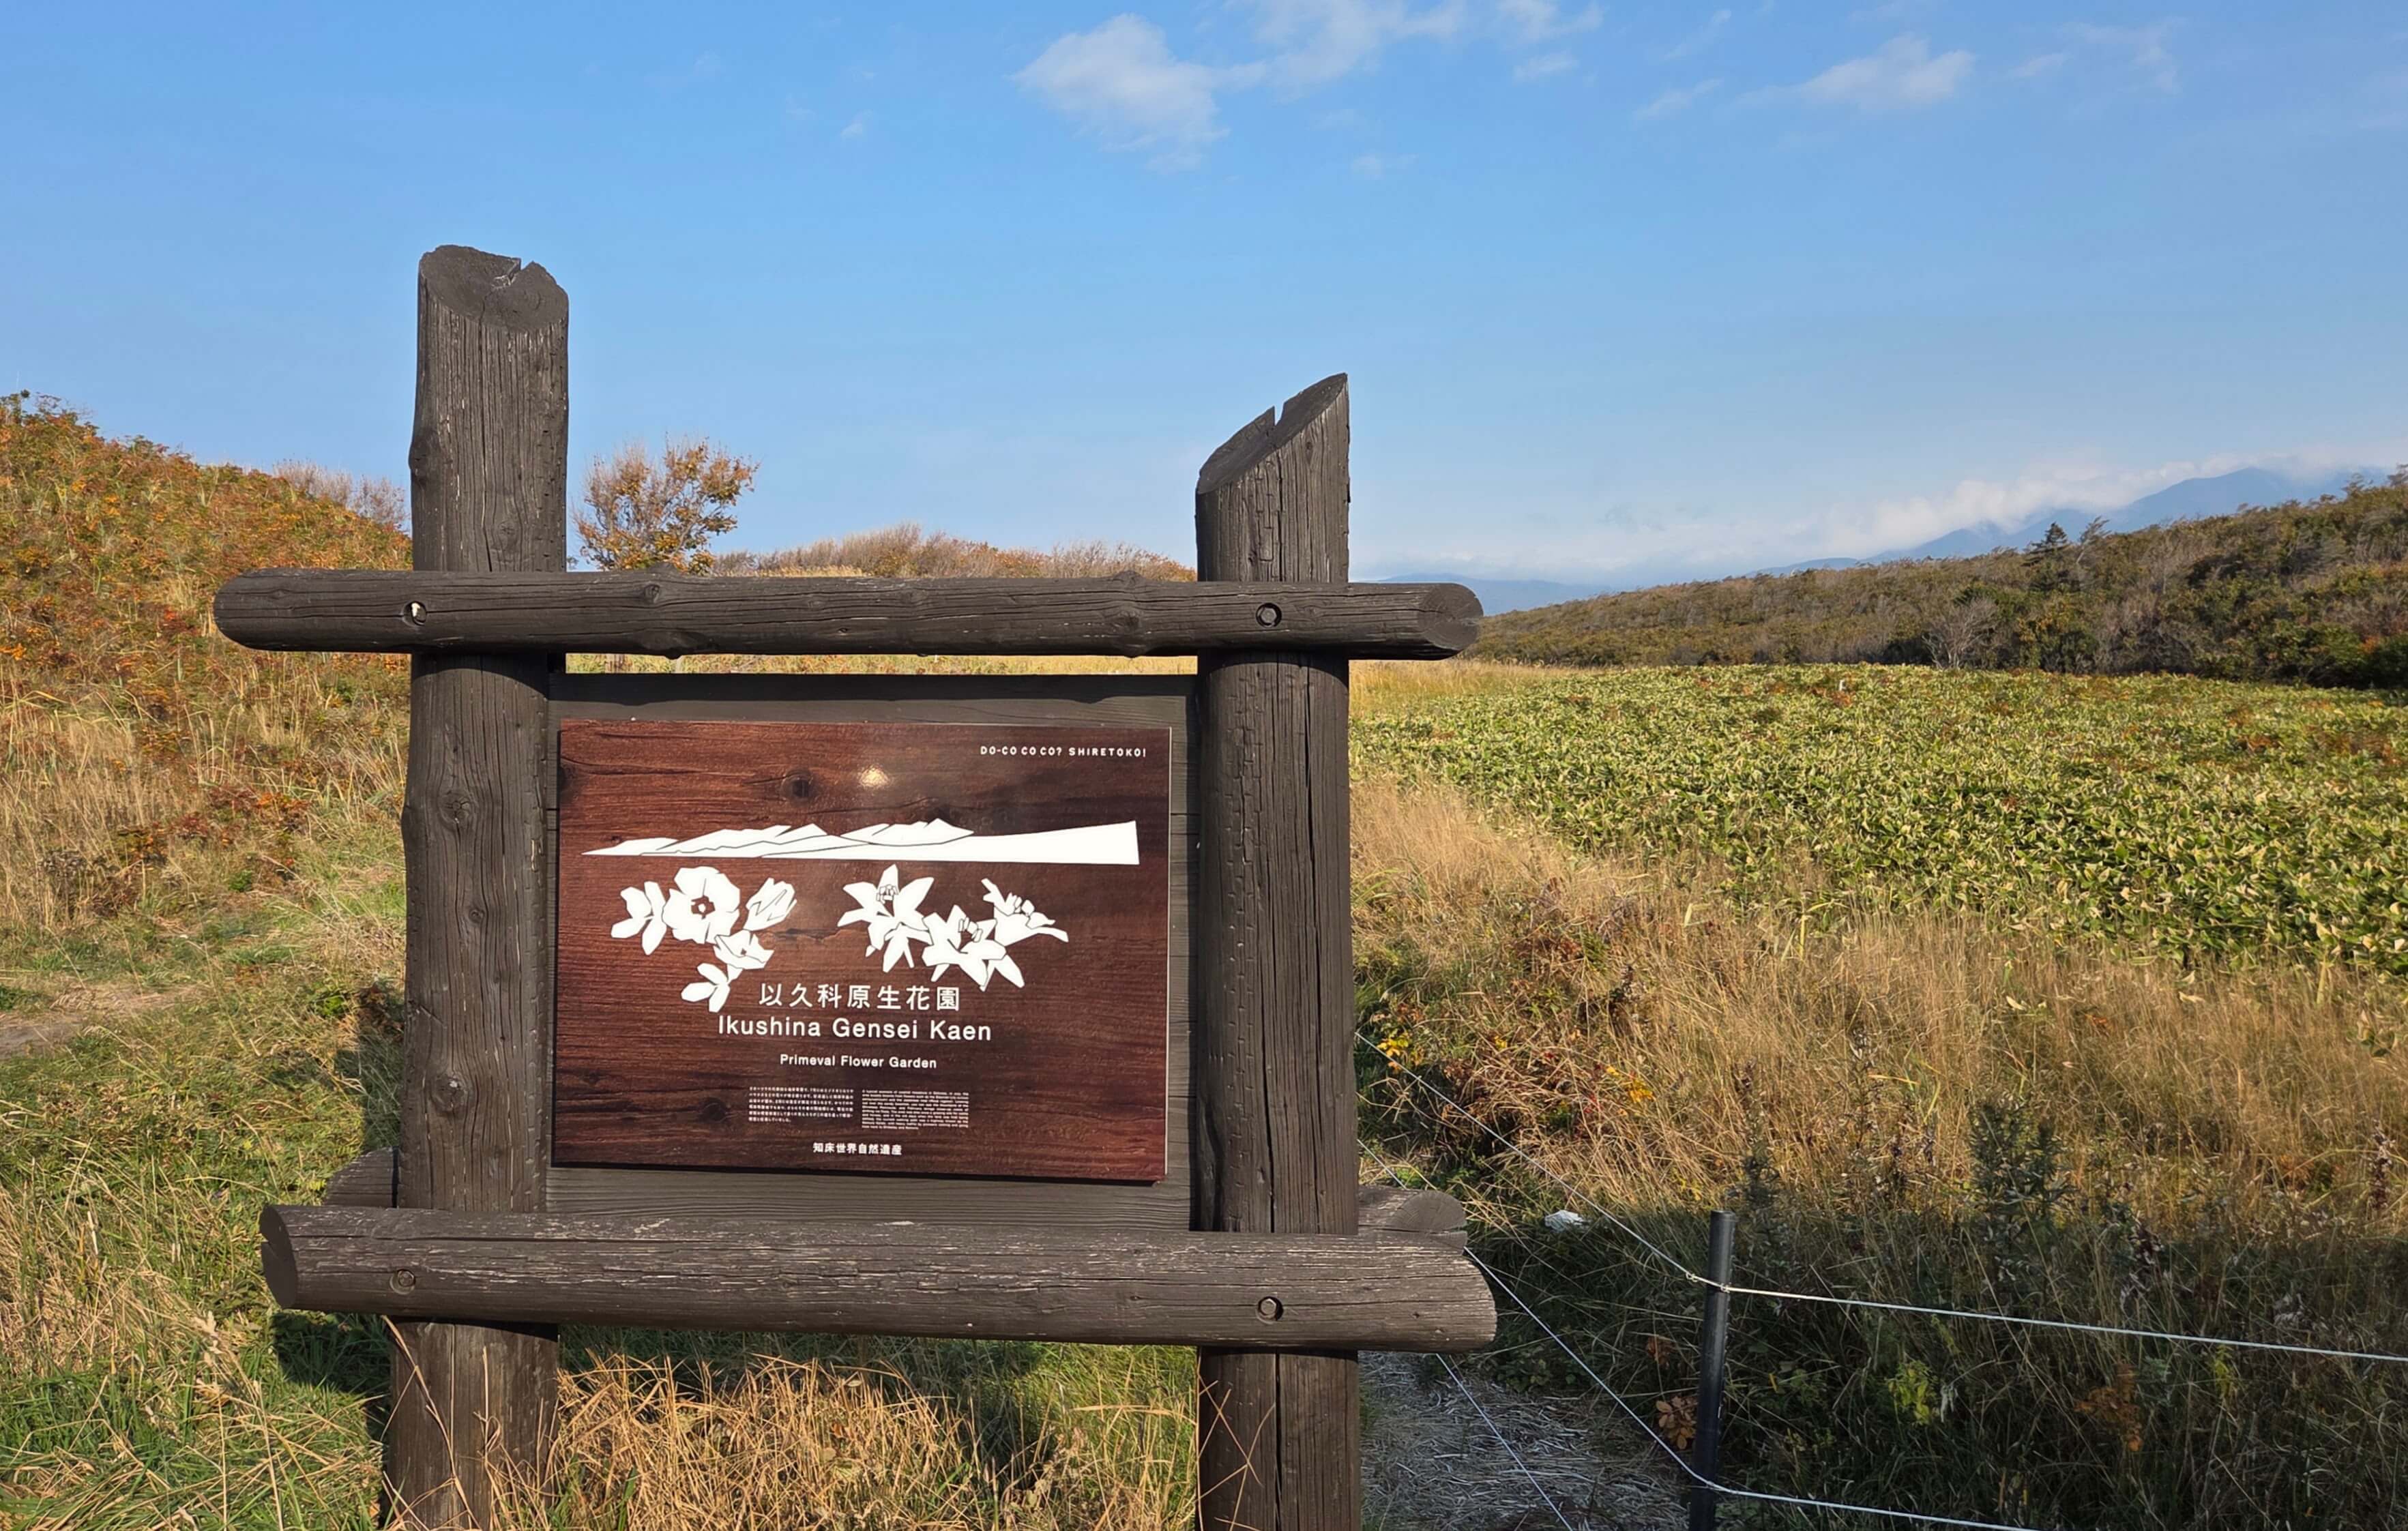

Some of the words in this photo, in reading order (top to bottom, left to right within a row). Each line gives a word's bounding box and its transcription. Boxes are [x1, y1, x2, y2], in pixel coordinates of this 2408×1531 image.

[1068, 747, 1146, 758] SHIRETOKO!
[759, 983, 960, 1011] 以久科原生花園
[718, 1015, 821, 1037] Ikushina
[832, 1017, 917, 1039] Gensei
[930, 1020, 991, 1041] Kaen
[780, 1054, 836, 1066] Primeval
[840, 1055, 885, 1067] Flower
[889, 1056, 937, 1069] Garden
[812, 1142, 902, 1155] 知床世界自然遺産
